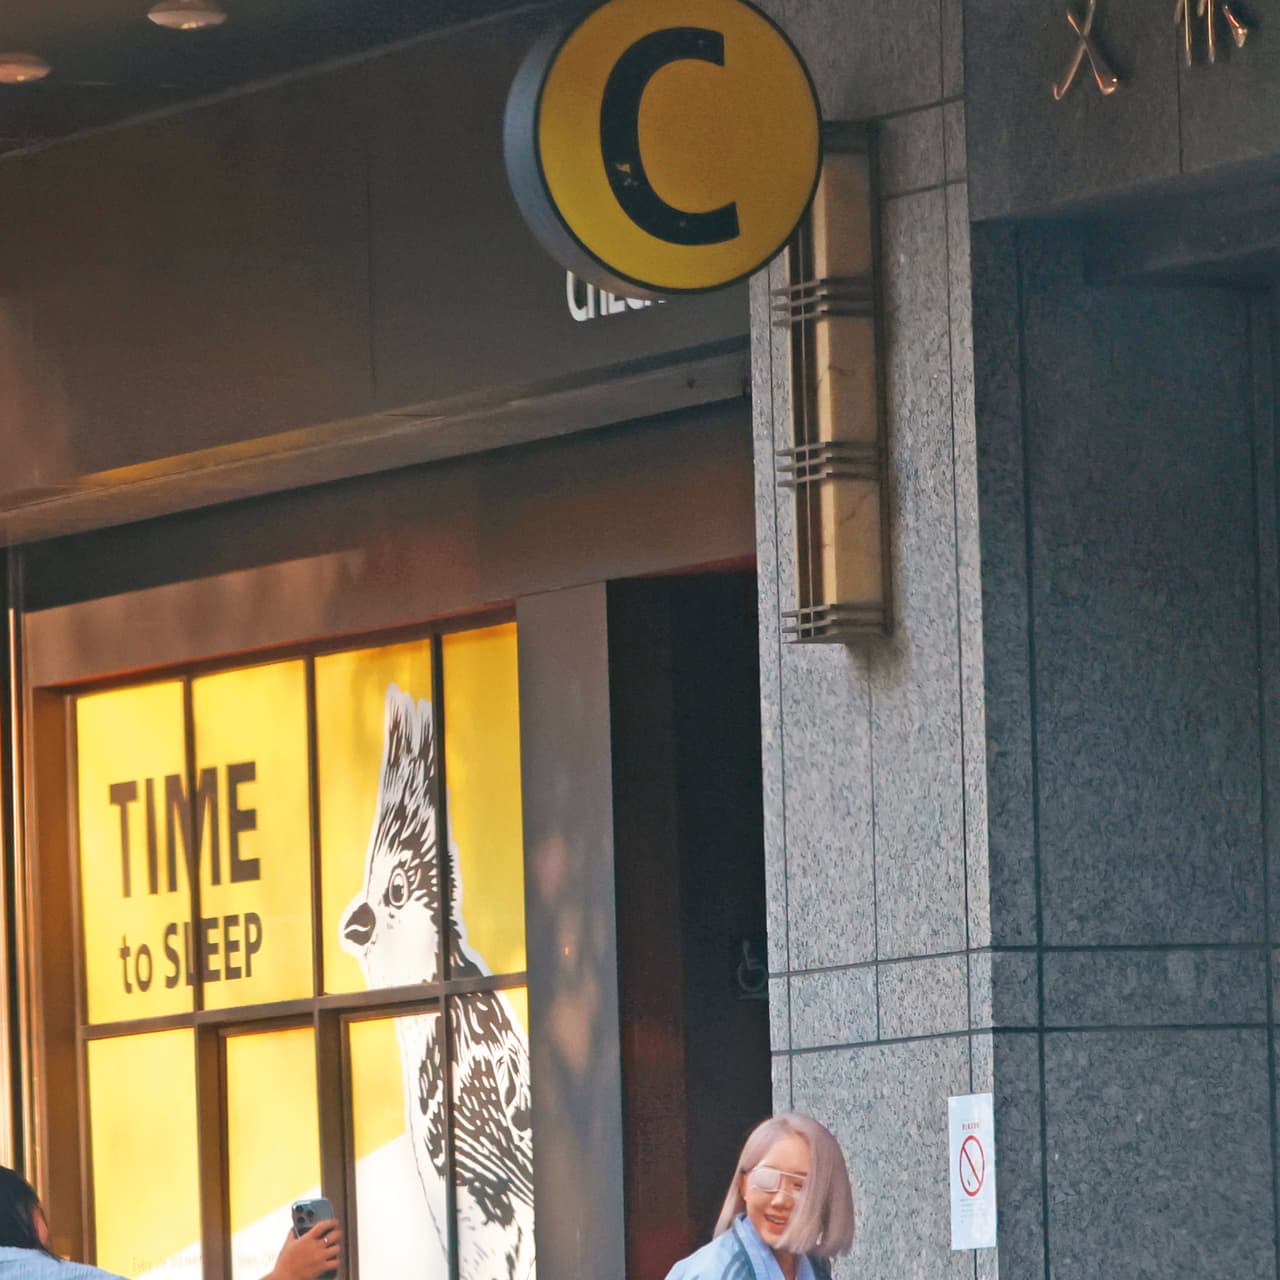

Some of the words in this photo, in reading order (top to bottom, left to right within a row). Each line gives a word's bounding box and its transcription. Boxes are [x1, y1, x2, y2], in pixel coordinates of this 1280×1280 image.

[600, 26, 740, 246] C
[109, 761, 261, 898] TIME
[119, 933, 153, 994] to
[164, 911, 263, 989] SLEEP
